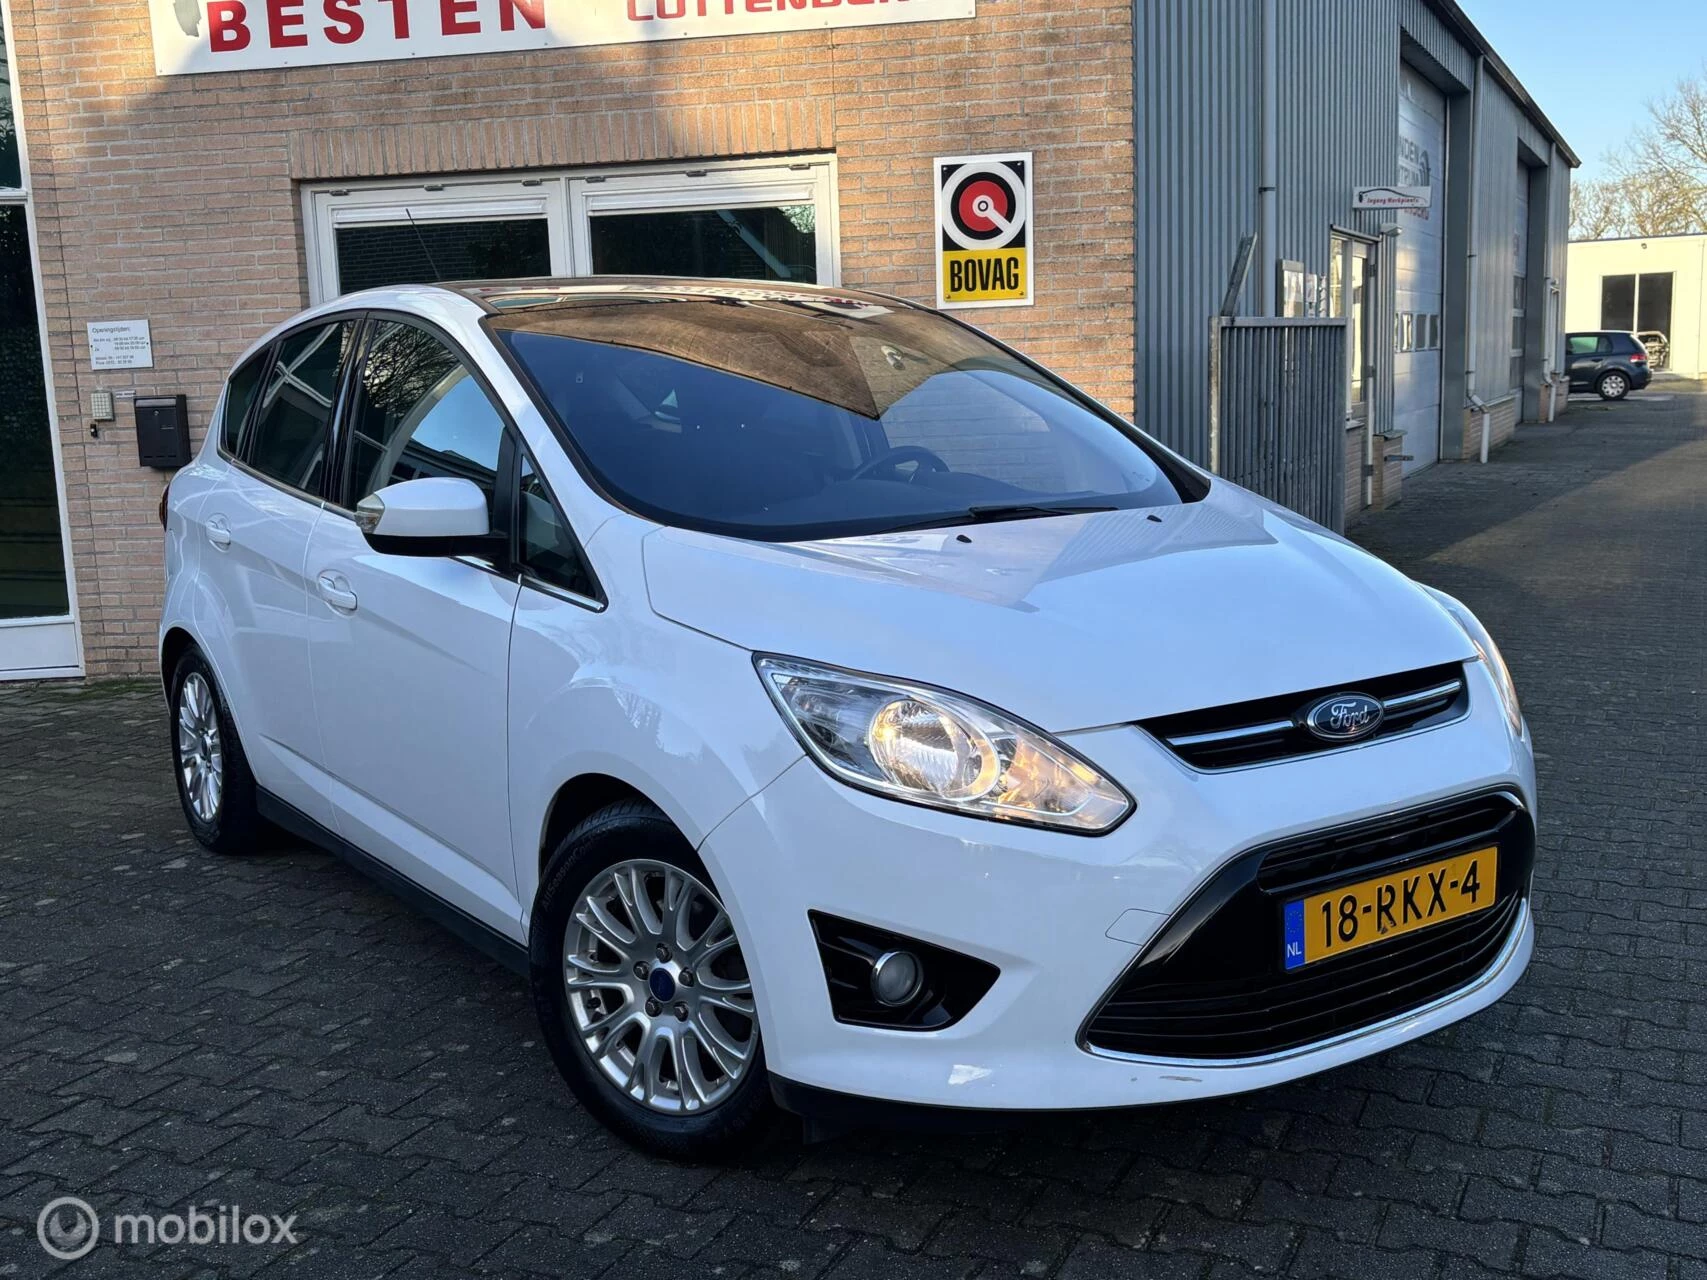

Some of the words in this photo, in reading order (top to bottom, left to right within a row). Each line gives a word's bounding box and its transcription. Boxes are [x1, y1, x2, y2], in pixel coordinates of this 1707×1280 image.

[206, 0, 547, 53] BESTEN
[949, 256, 1020, 293] BOVAG
[1330, 701, 1370, 729] Ford
[1322, 860, 1481, 947] 18-RKX-4
[1286, 941, 1302, 959] NL
